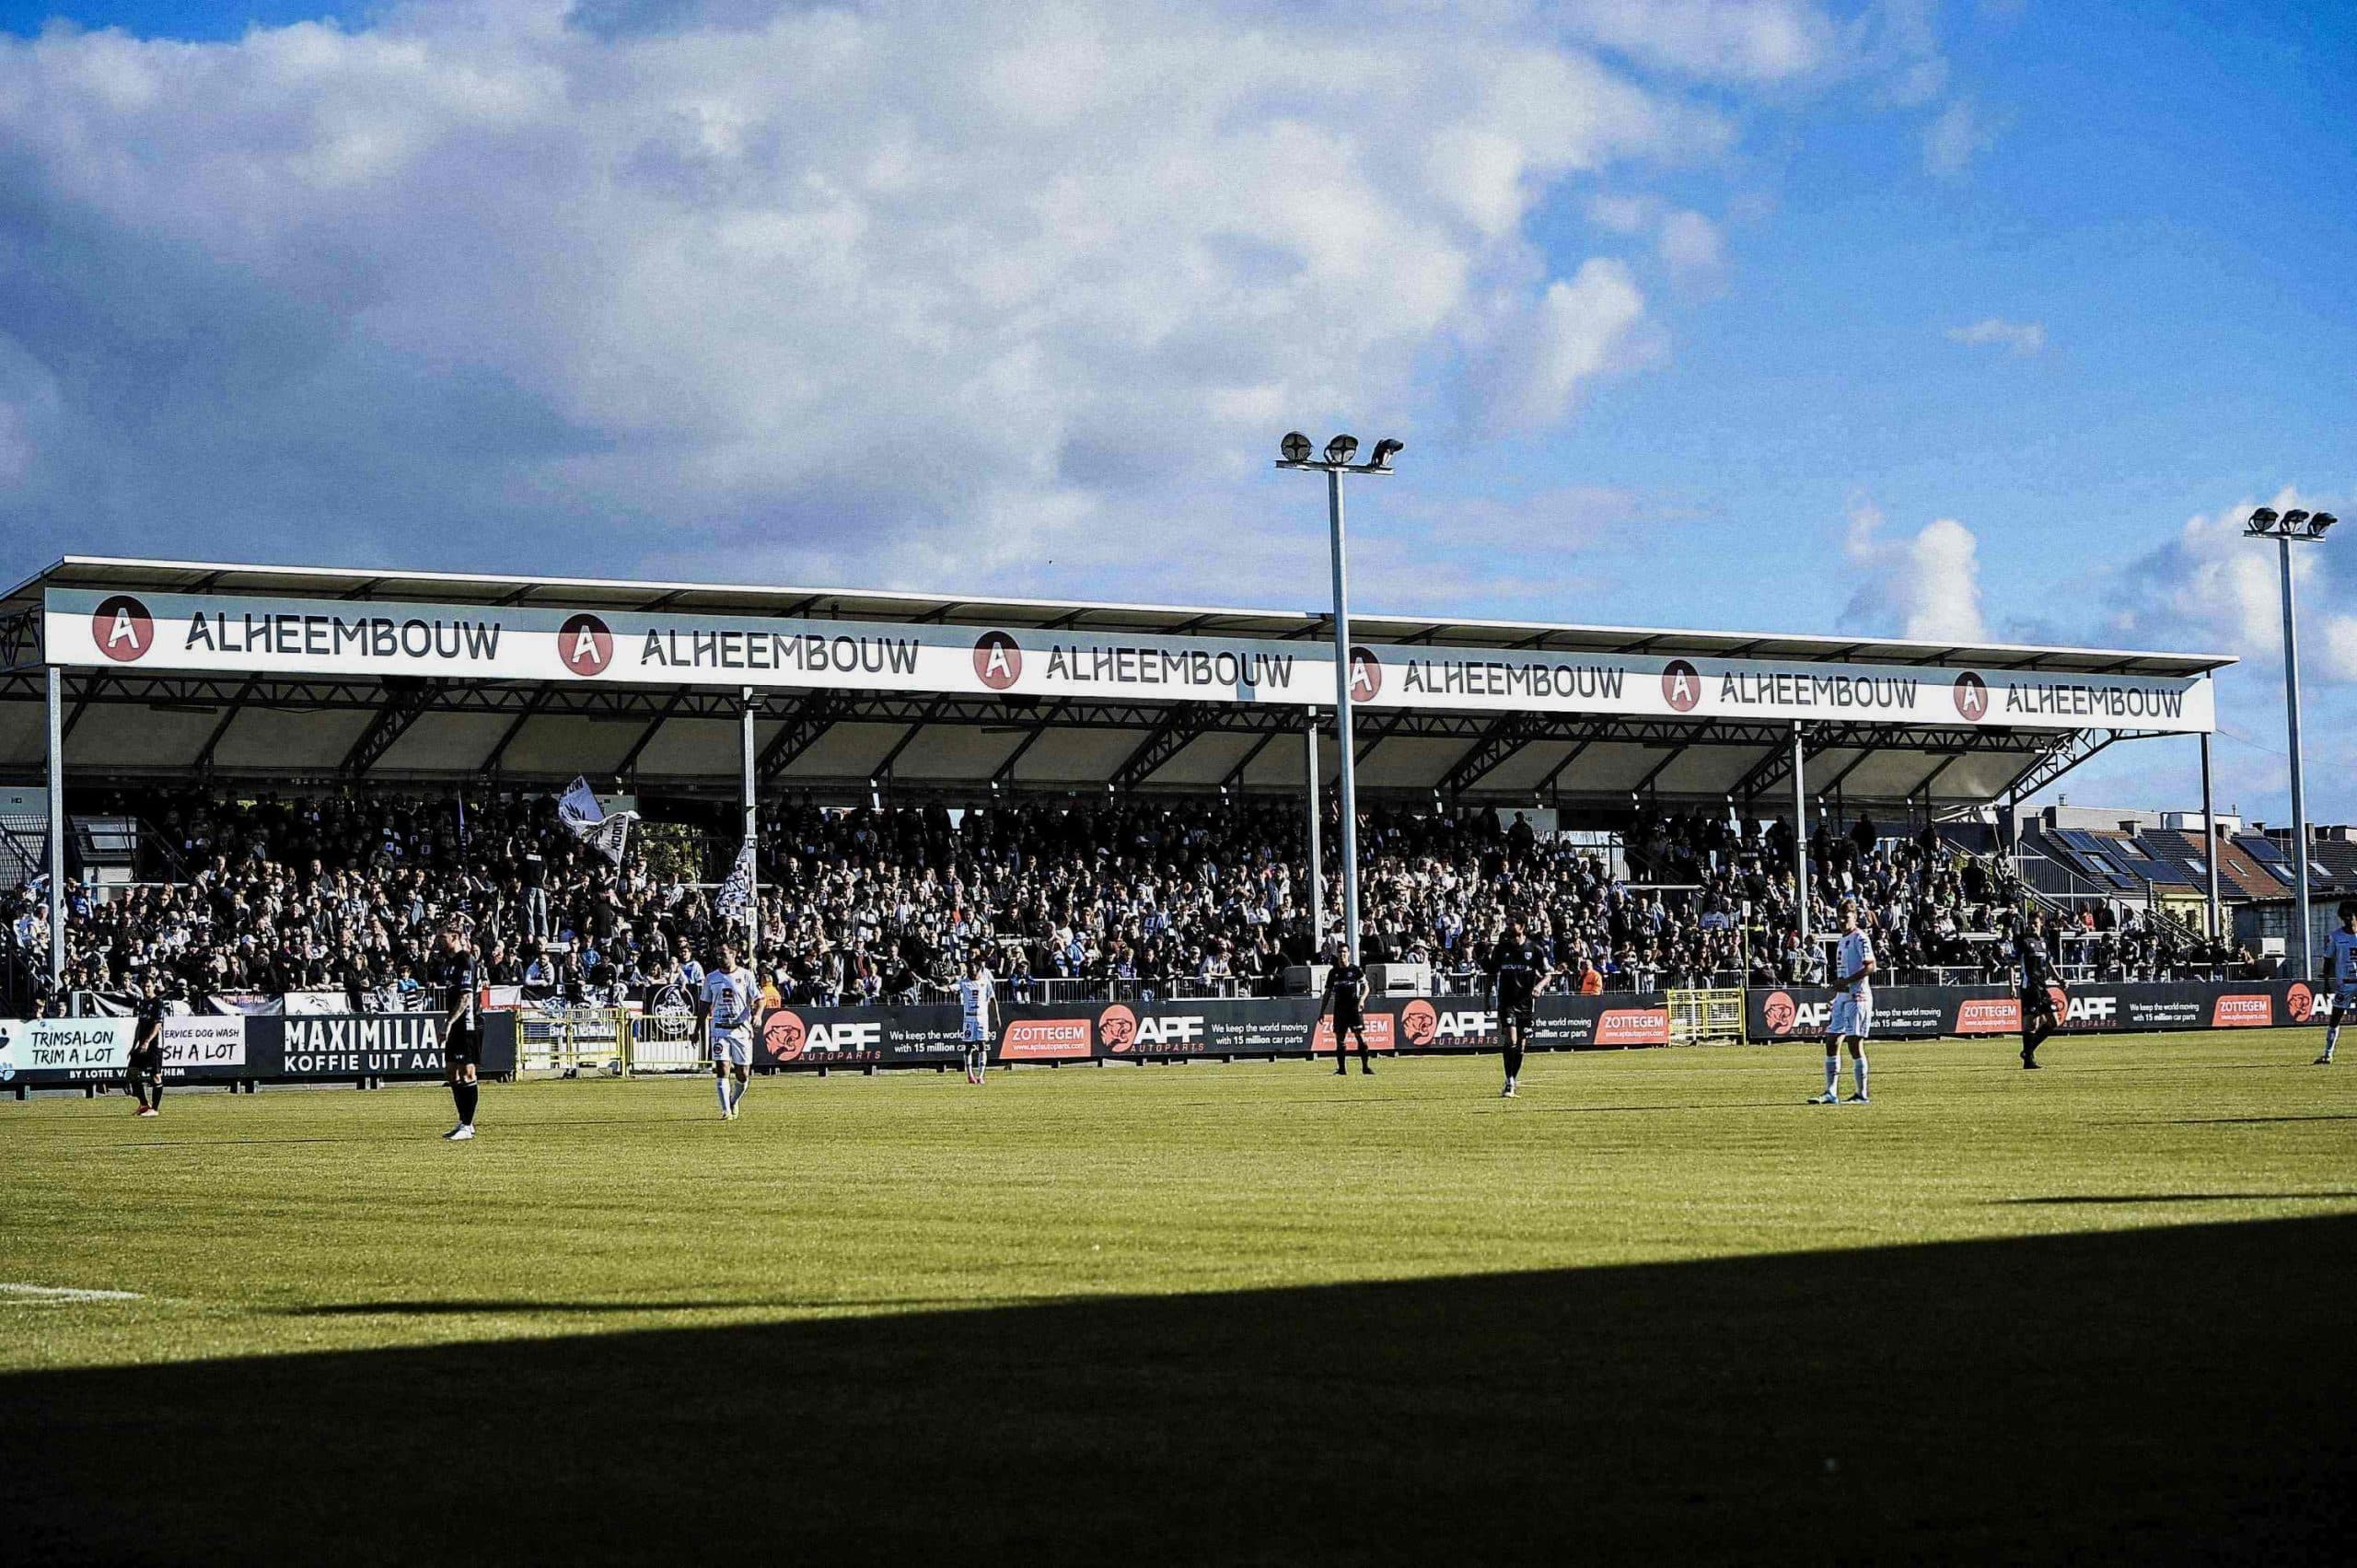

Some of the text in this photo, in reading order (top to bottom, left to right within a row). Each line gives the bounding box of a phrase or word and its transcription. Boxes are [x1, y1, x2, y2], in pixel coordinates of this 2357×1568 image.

[185, 611, 501, 660] ALHEEMBOUW
[641, 628, 919, 675] ALHEEMBOUW
[1046, 645, 1293, 688] ALHEEMBOUW
[1403, 659, 1624, 699] ALHEEMBOUW
[1720, 671, 1917, 708] ALHEEMBOUW
[2006, 682, 2182, 718] ALHEEMBOUW
[1965, 1005, 2016, 1016] ZOTTEGEM
[2066, 997, 2116, 1020] APF
[2221, 1000, 2267, 1012] ZOTTEGEM
[1875, 1009, 1891, 1018] keep
[1891, 1007, 1900, 1016] the
[1902, 1007, 1919, 1016] world
[1920, 1007, 1941, 1016] moving
[2145, 1013, 2153, 1021] 15
[1212, 1022, 1307, 1034] We keep the world moving
[1434, 1011, 1498, 1037] APF
[1536, 1017, 1547, 1026] the
[1548, 1017, 1566, 1026] world
[1567, 1017, 1591, 1028] moving
[1605, 1016, 1664, 1028] ZOTTEGEM
[1882, 1019, 1889, 1028] 15
[1891, 1018, 1911, 1027] million
[1922, 1020, 1937, 1028] parts
[195, 1029, 214, 1038] DOG
[215, 1028, 239, 1038] WASH
[284, 1018, 447, 1051] MAXIMILIA
[889, 1031, 903, 1040] We
[906, 1029, 926, 1041] keep
[928, 1029, 941, 1040] the
[1013, 1027, 1084, 1040] ZOTTEGEM
[1133, 1016, 1204, 1044] APF
[1535, 1029, 1558, 1038] million
[1571, 1030, 1587, 1039] parts
[31, 1031, 113, 1047] TRIMSALON
[802, 1023, 881, 1051] APF
[1216, 1037, 1232, 1045] with
[1234, 1036, 1243, 1044] 15
[1245, 1035, 1271, 1044] million
[1284, 1036, 1303, 1046] parts
[1431, 1037, 1499, 1045] AUTOPARTS
[188, 1044, 199, 1061] A
[205, 1044, 237, 1061] LOT
[895, 1043, 911, 1053] with
[914, 1043, 925, 1052] 15
[926, 1042, 955, 1052] million
[1131, 1043, 1204, 1052] AUTOPARTS
[32, 1048, 114, 1064] TRIM A LOT
[798, 1051, 881, 1061] AUTOPARTS
[284, 1054, 359, 1072] KOFFIE
[368, 1053, 402, 1070] UIT
[70, 1070, 81, 1078] BY
[86, 1070, 112, 1078] LOTTE
